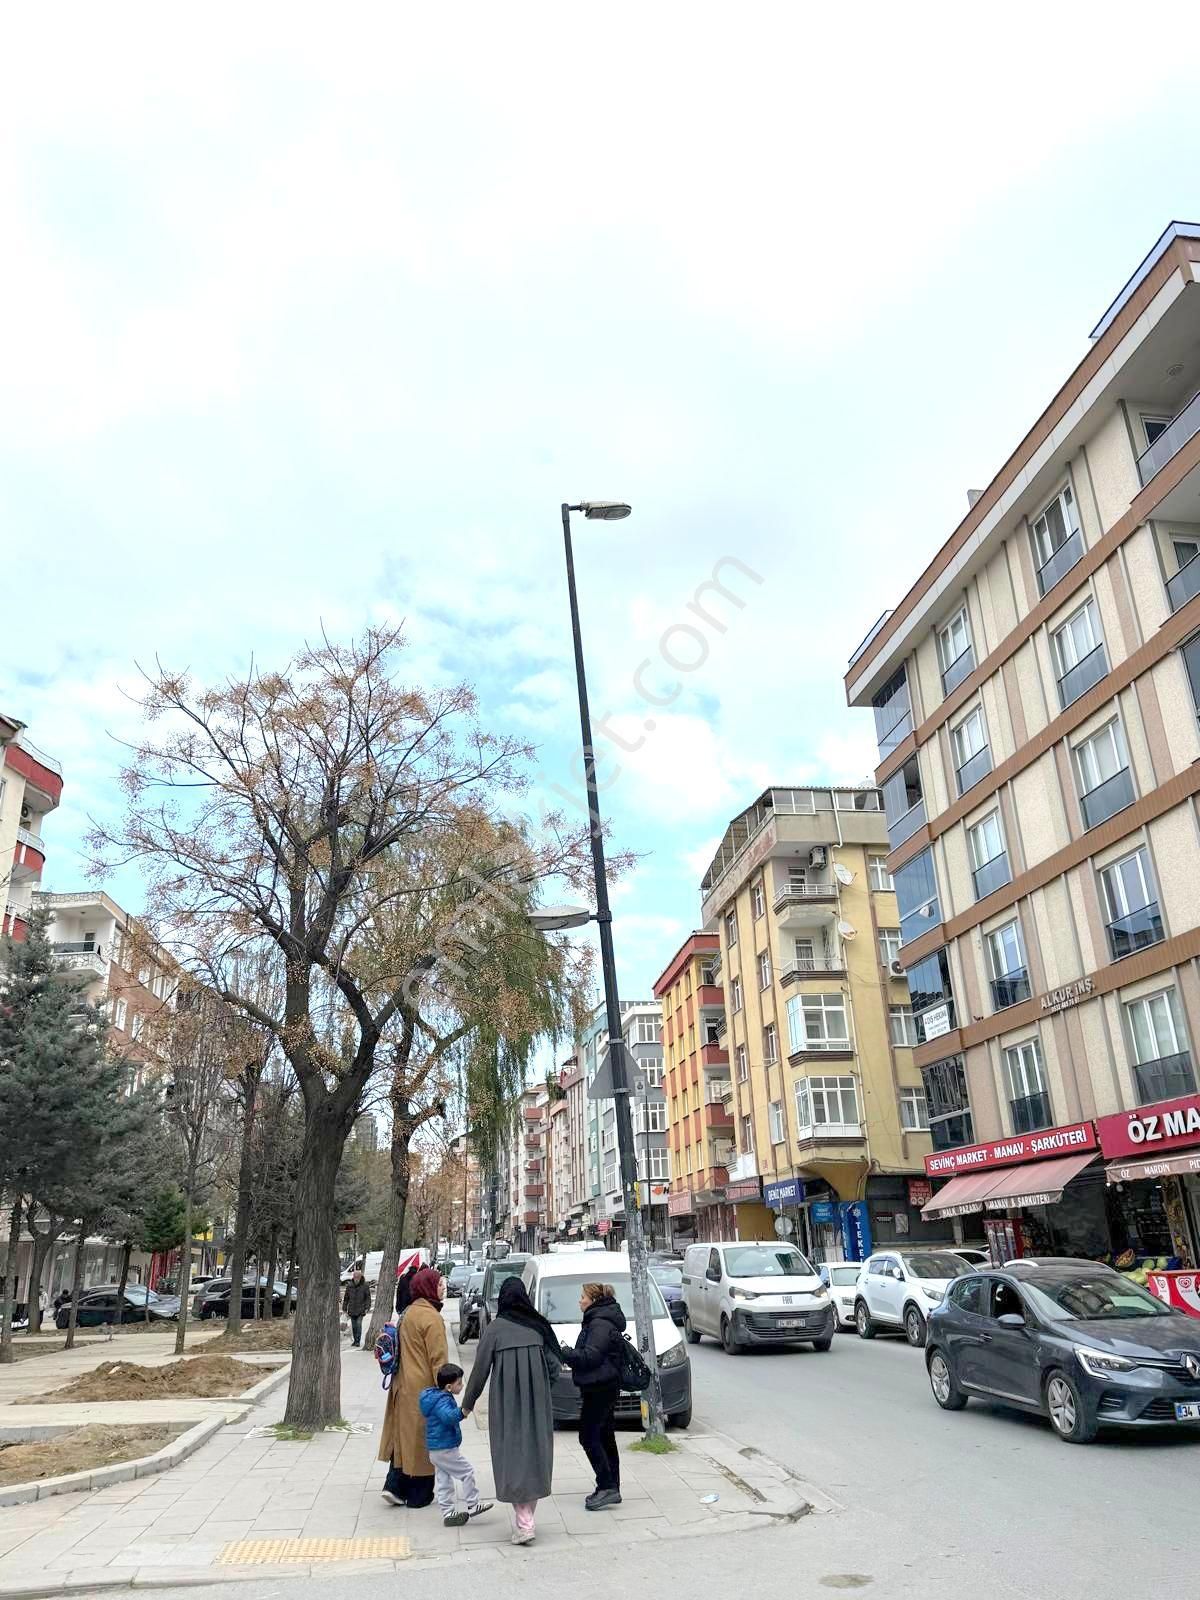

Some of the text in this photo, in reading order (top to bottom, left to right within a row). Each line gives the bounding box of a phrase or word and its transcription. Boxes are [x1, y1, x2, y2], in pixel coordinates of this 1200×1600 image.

[1040, 986, 1074, 1009] ALKUR
[1127, 1107, 1200, 1144] ÖZ MA
[930, 1154, 955, 1170] SEVİNÇ
[956, 1150, 987, 1166] MARKET
[994, 1142, 1024, 1159] MANAV
[1031, 1126, 1087, 1154] ŞARKÜTERİ
[1143, 1162, 1171, 1176] MARDİN
[780, 1184, 796, 1200] MARKET
[1182, 1406, 1193, 1417] 34
